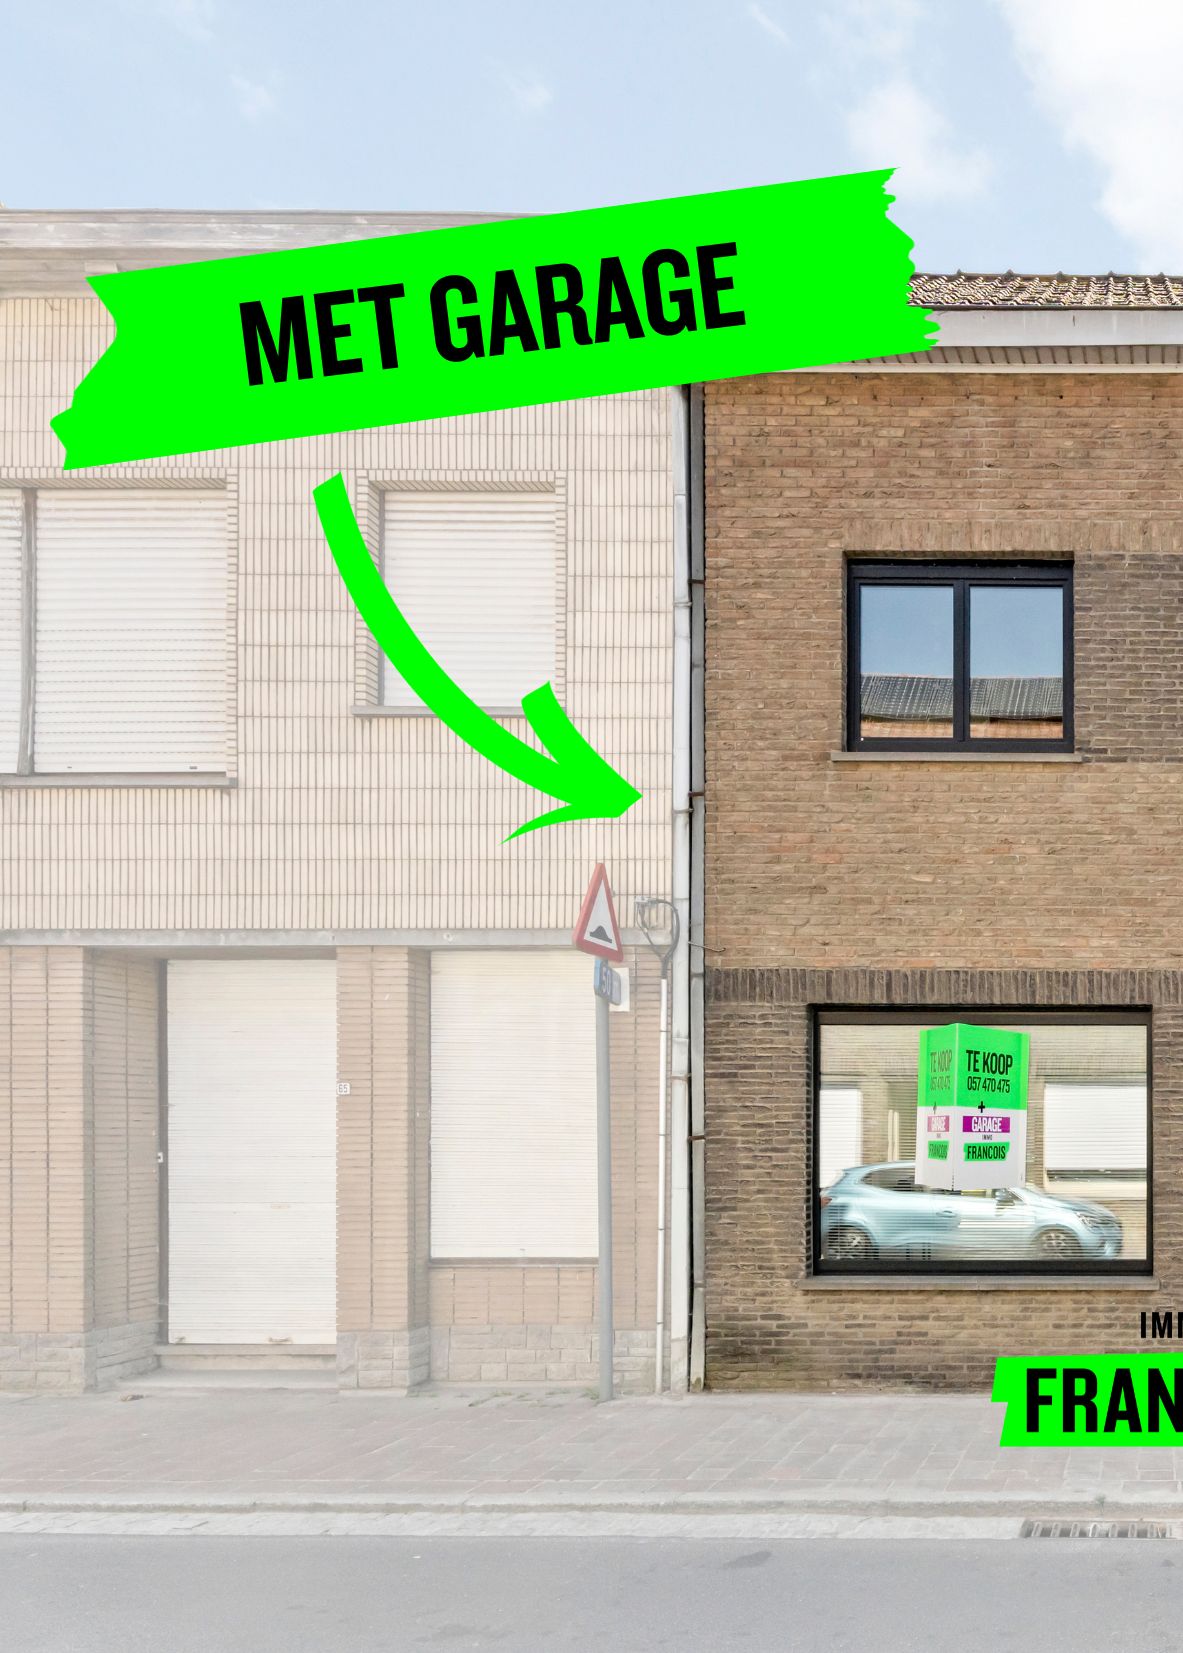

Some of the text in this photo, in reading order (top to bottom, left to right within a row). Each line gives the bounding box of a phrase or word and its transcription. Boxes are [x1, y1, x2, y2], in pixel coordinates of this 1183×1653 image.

[966, 1049, 1014, 1076] TE KOOP
[967, 1076, 1011, 1094] 057 470 475
[971, 1116, 1003, 1132] GARAGE
[967, 1145, 1006, 1160] FRANCOIS
